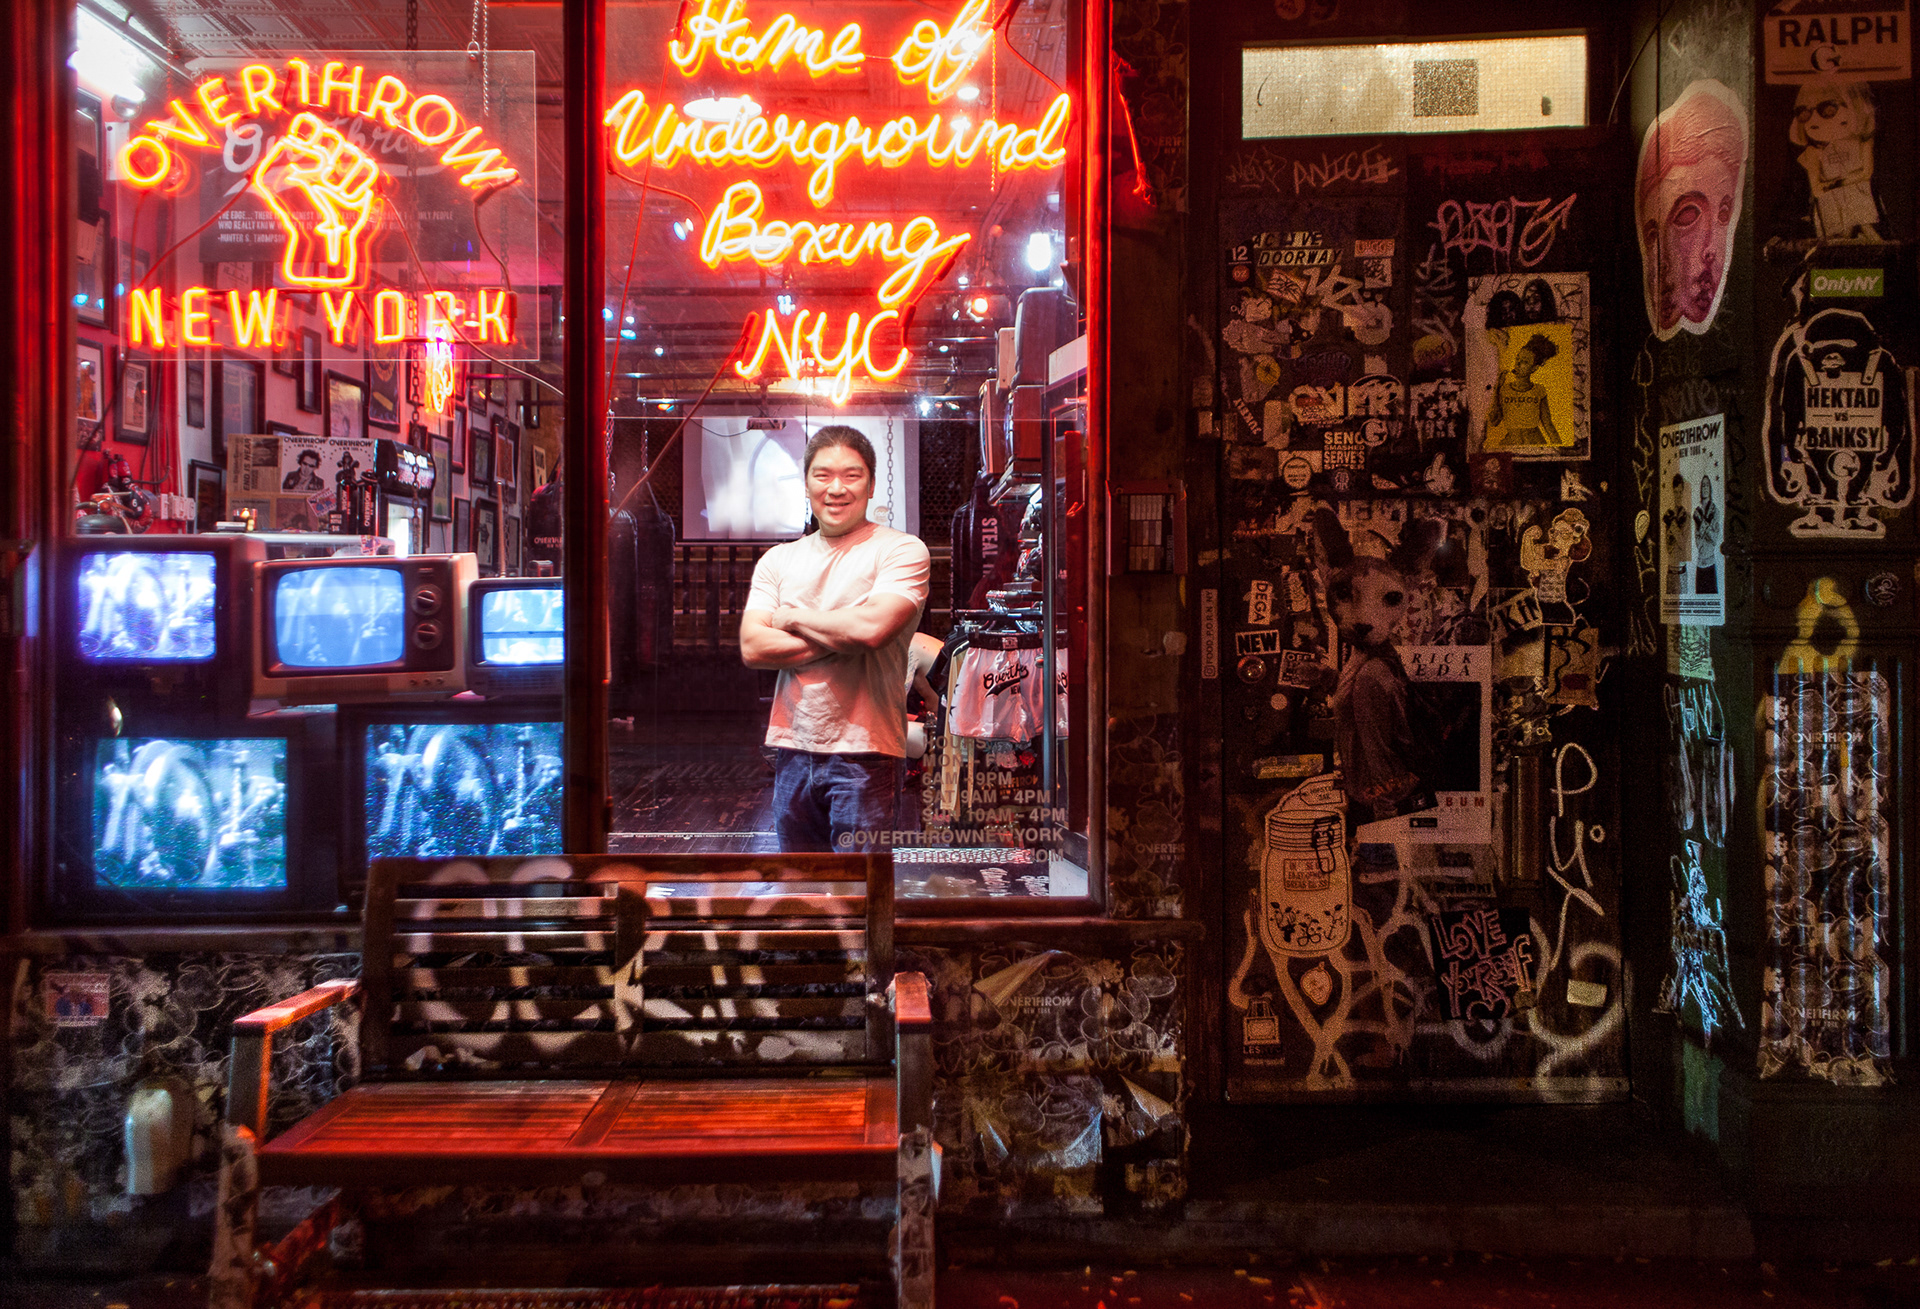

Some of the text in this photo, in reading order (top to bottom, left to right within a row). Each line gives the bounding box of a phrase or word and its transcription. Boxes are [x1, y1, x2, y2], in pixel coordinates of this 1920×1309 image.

[1779, 15, 1897, 47] RALPH
[669, 0, 990, 100] Home of
[119, 58, 520, 191] OVERTHROW
[603, 90, 1070, 206] Underground
[702, 180, 971, 306] Boxing
[1254, 231, 1322, 249] ACIVE
[1232, 245, 1248, 260] 12
[1258, 250, 1343, 265] DOORWAY
[128, 287, 512, 348] NEW YORK
[735, 307, 912, 406] NYC
[1807, 387, 1880, 408] HEKTAD
[329, 439, 373, 448] OVERTHROW
[1660, 421, 1721, 448] OVERTHROW
[1807, 426, 1880, 448] BANKSY
[981, 517, 998, 559] STEAL
[1253, 582, 1268, 622] DEGA
[1237, 632, 1278, 654] NEW
[1412, 653, 1472, 664] RICK
[922, 772, 961, 786] 6AM
[975, 771, 1013, 785] 9PM
[922, 790, 956, 804] SAT
[961, 790, 997, 803] 9AM
[1014, 789, 1051, 803] 4PM
[1028, 808, 1066, 822] 4PM
[839, 827, 1065, 848] @OVERTHROWNEWYORK
[1430, 909, 1508, 960] LOVE
